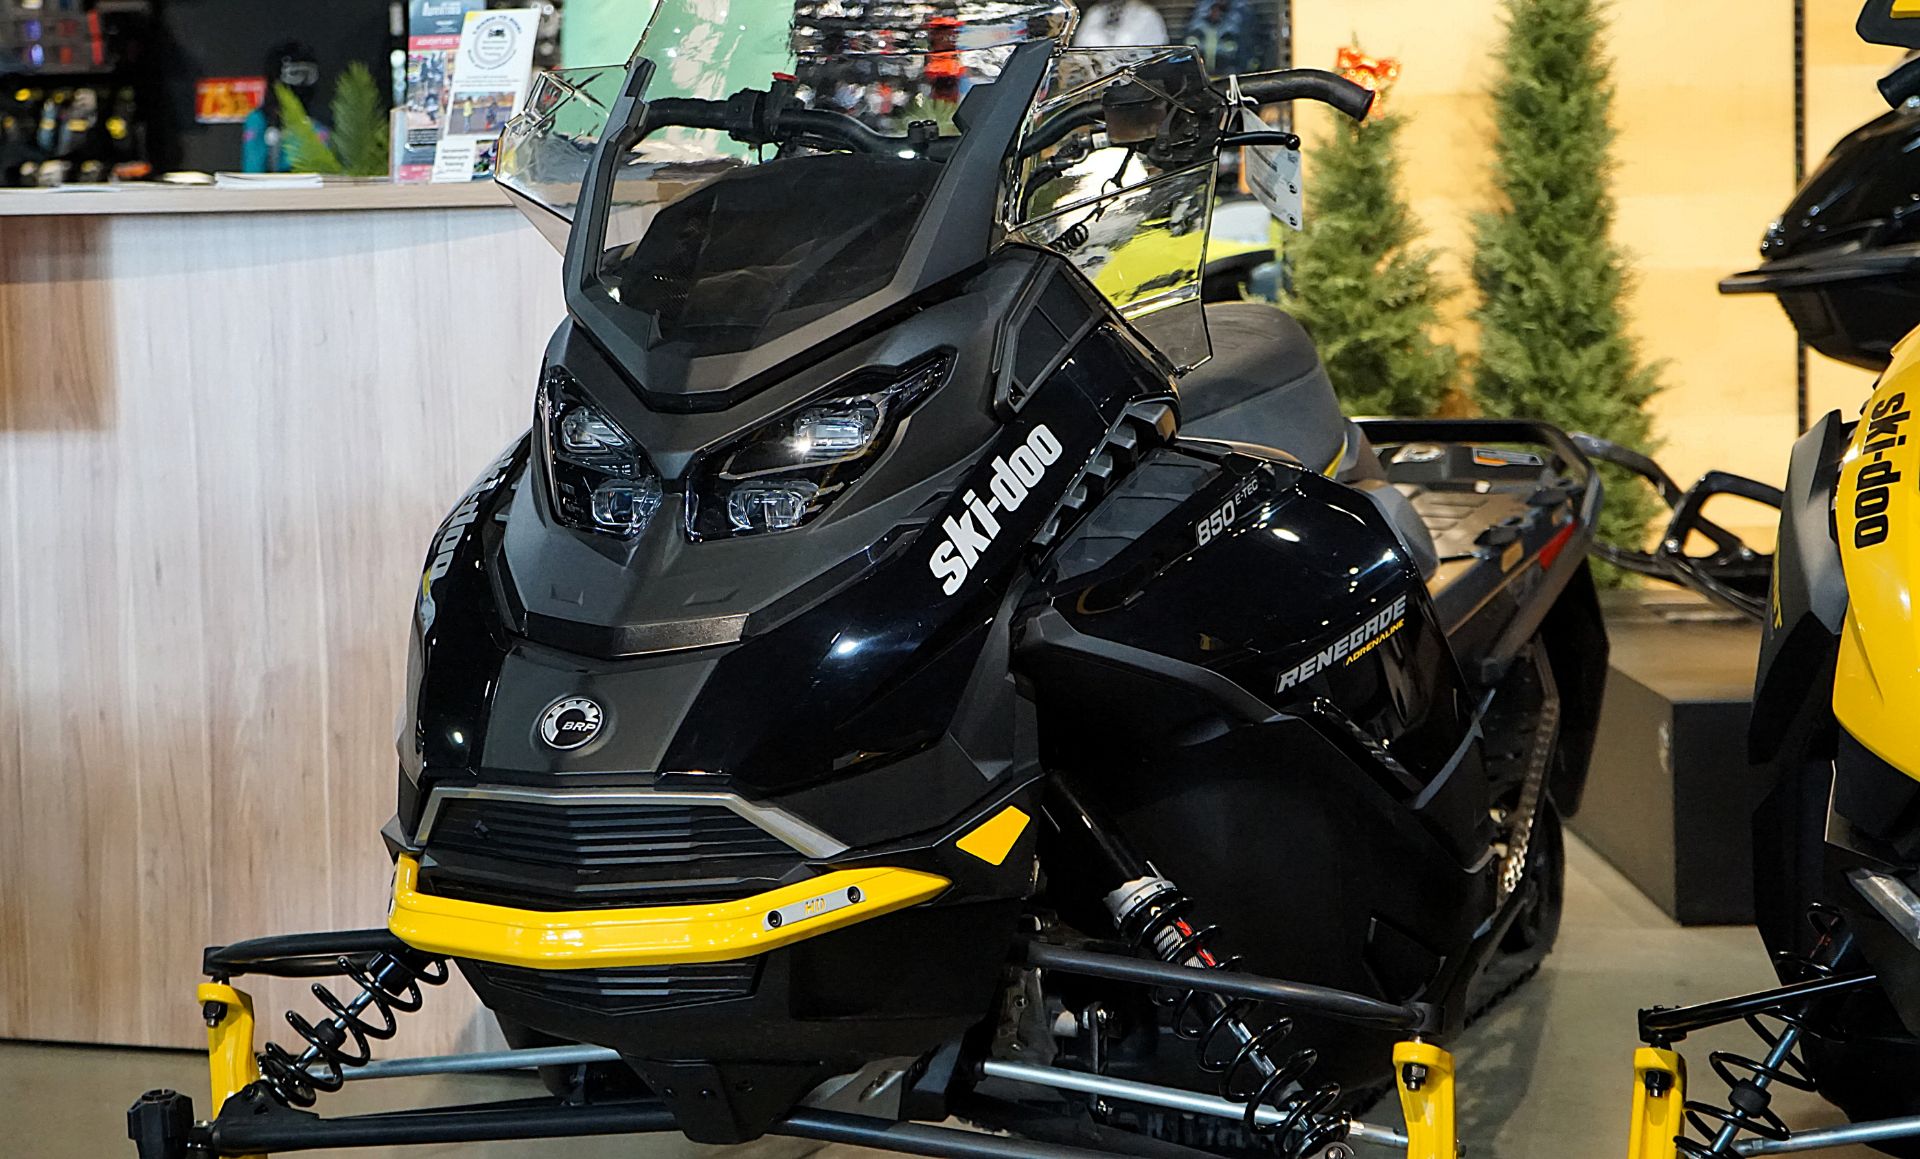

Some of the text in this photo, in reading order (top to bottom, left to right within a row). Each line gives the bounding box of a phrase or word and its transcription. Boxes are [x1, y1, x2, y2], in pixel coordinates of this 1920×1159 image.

[929, 424, 1063, 596] ski-doo
[1855, 391, 1911, 549] ski-doo
[1197, 479, 1258, 546] 850 E-TEC
[1277, 595, 1407, 693] RENEGADE
[1345, 618, 1405, 666] ADRENALINE
[562, 721, 597, 732] BRP
